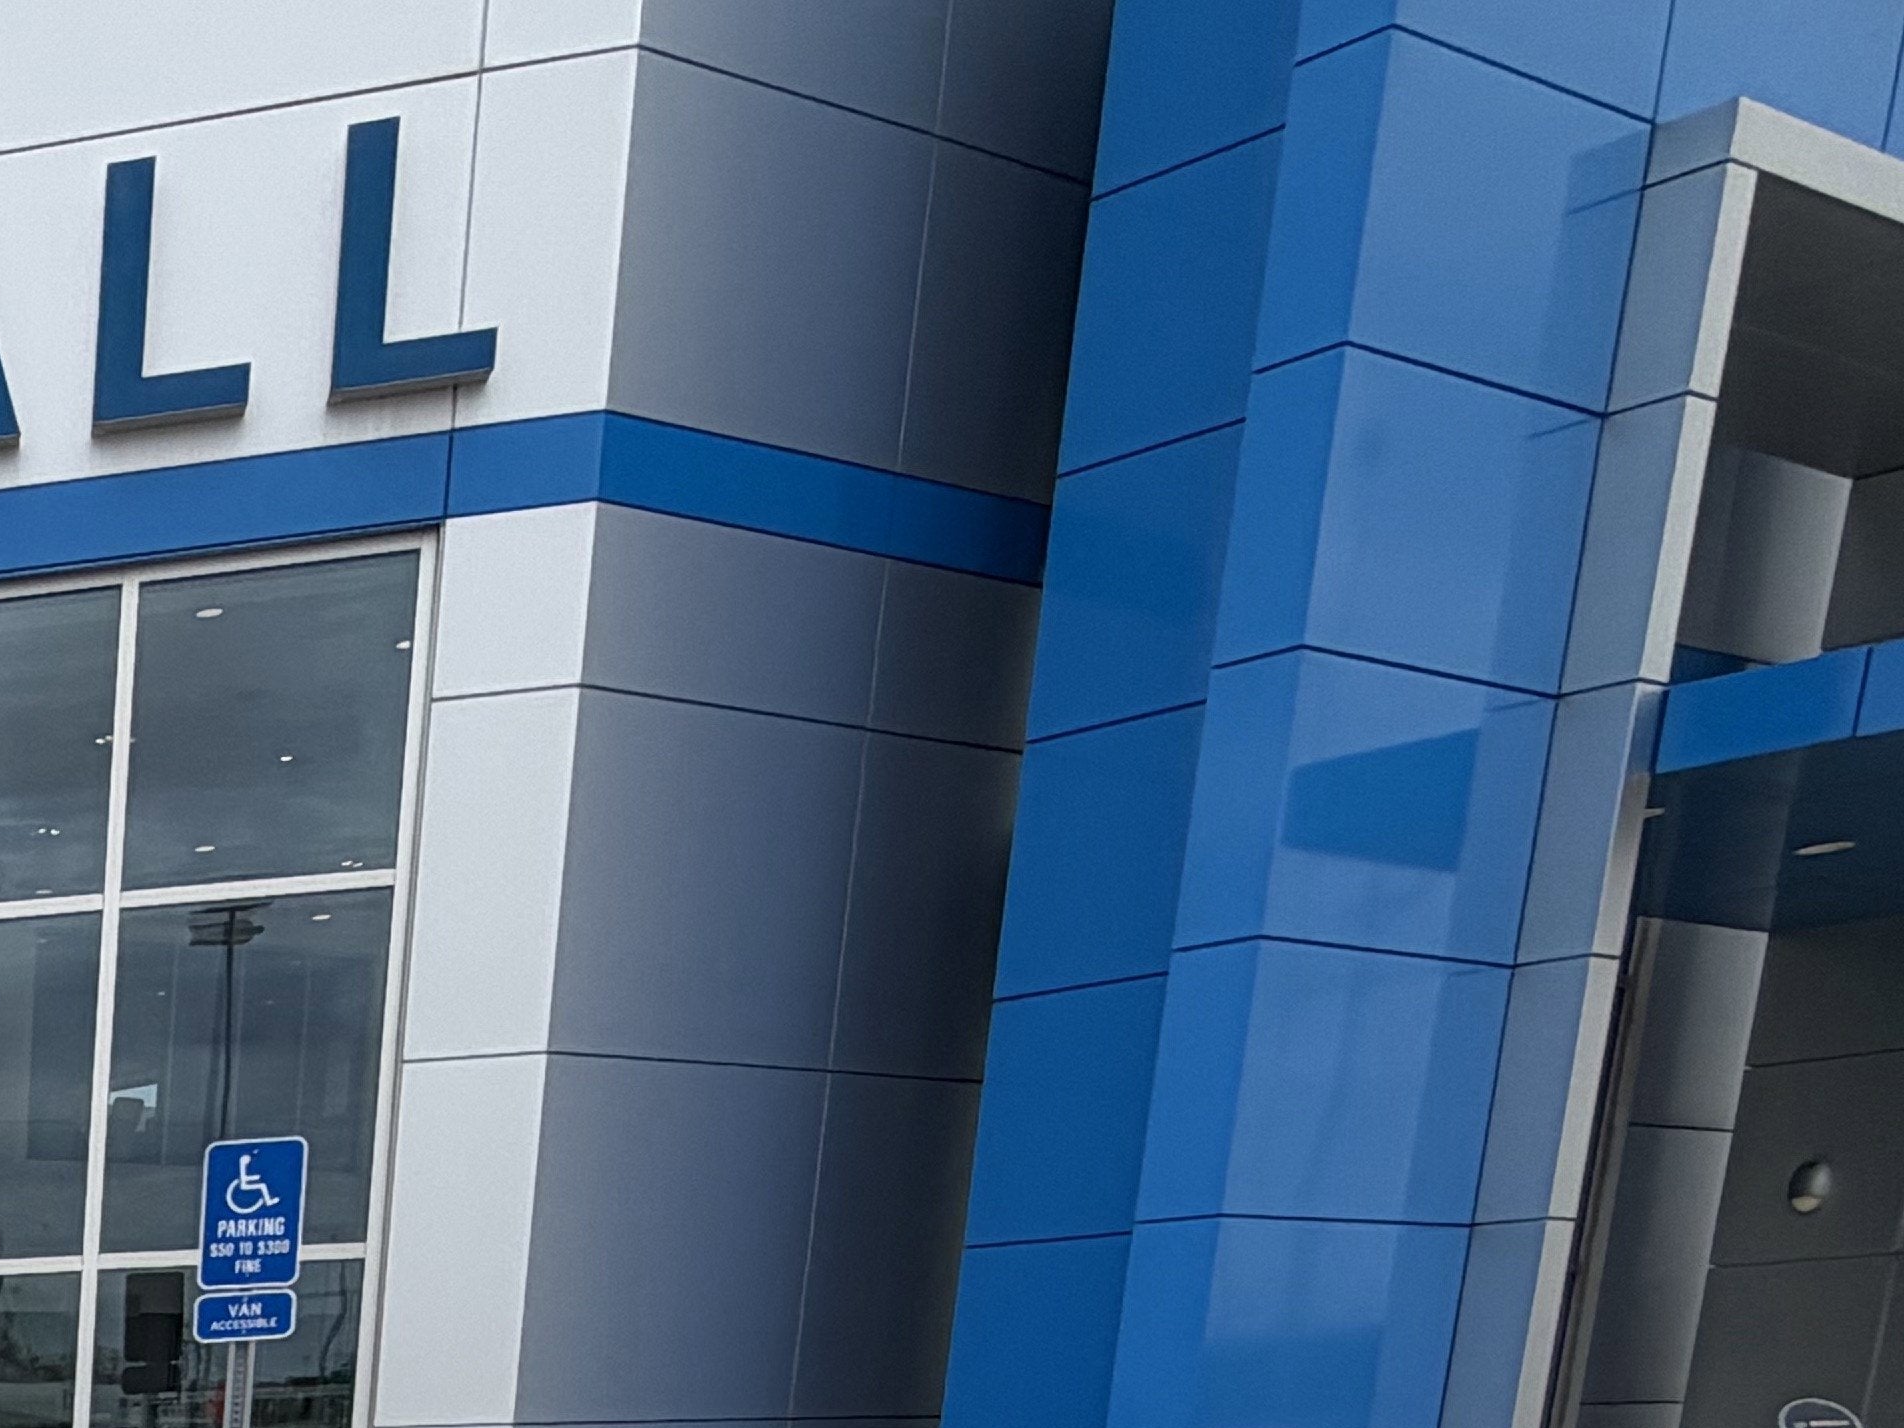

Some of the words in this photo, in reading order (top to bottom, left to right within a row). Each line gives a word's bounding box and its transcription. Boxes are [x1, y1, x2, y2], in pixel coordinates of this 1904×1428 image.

[217, 1216, 286, 1238] PARKING
[210, 1242, 234, 1258] $50
[238, 1241, 254, 1256] TO
[234, 1259, 262, 1274] FINE
[228, 1302, 262, 1318] VAN
[210, 1317, 278, 1332] ACCESSIBLE
